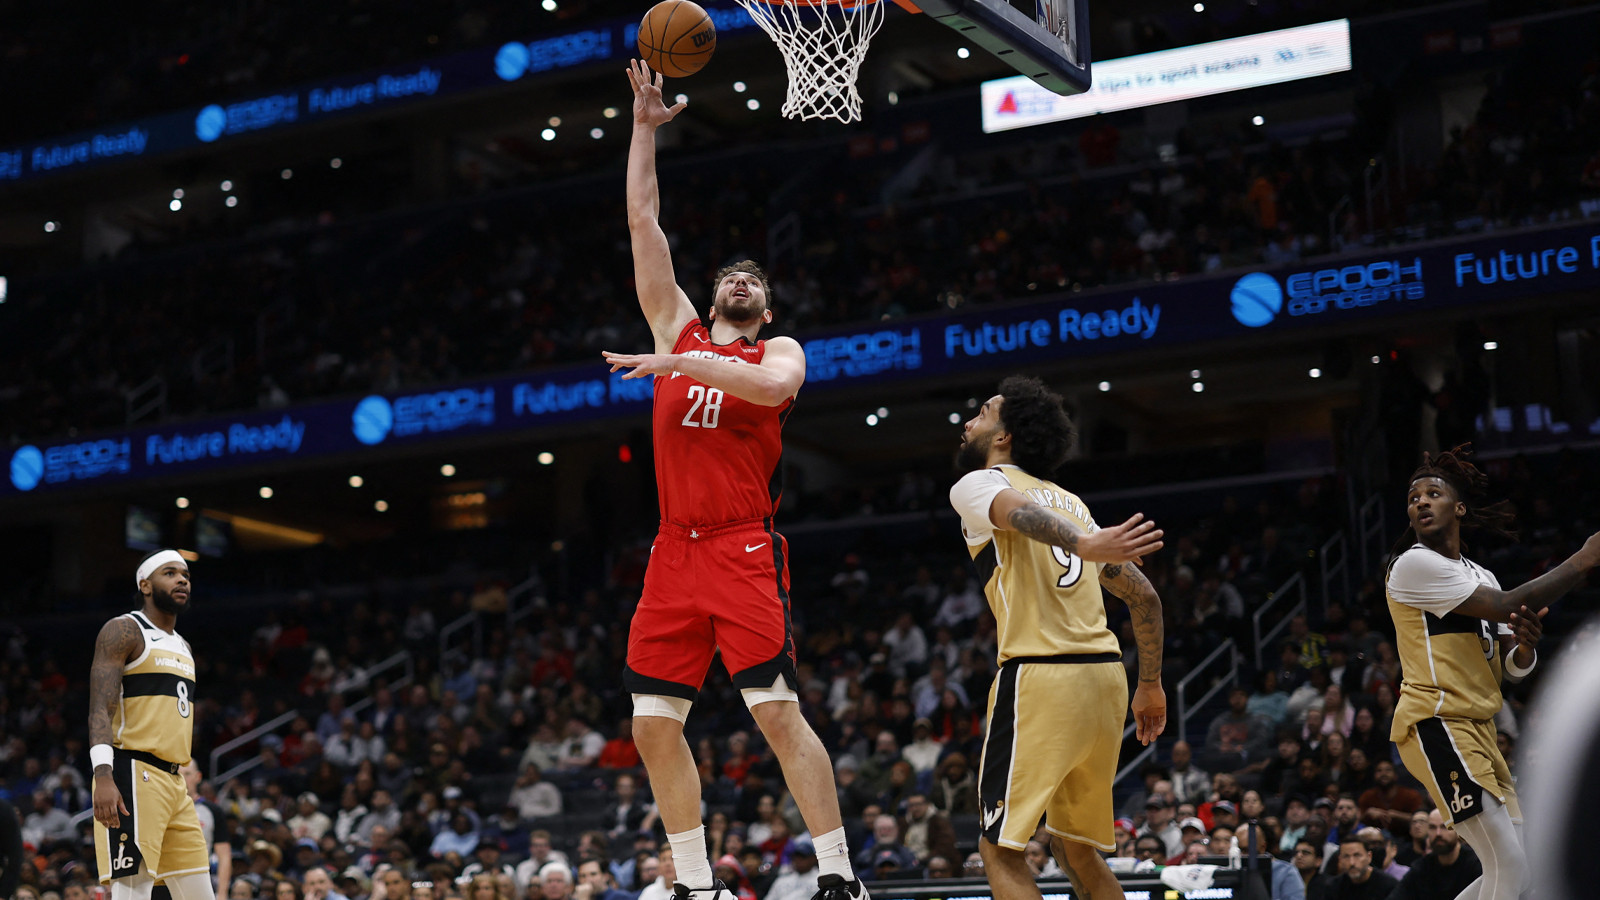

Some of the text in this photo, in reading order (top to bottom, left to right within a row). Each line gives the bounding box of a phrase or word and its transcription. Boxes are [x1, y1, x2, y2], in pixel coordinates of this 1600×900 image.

[1286, 257, 1422, 298] EPOCH
[1454, 246, 1579, 287] Future
[944, 319, 1052, 358] Future
[1058, 296, 1161, 342] Ready
[512, 379, 606, 416] Future
[682, 385, 724, 428] 28
[145, 433, 225, 465] Future
[228, 415, 305, 454] Ready
[1050, 545, 1083, 588] 9
[1480, 618, 1494, 660] 5
[176, 680, 191, 719] 8
